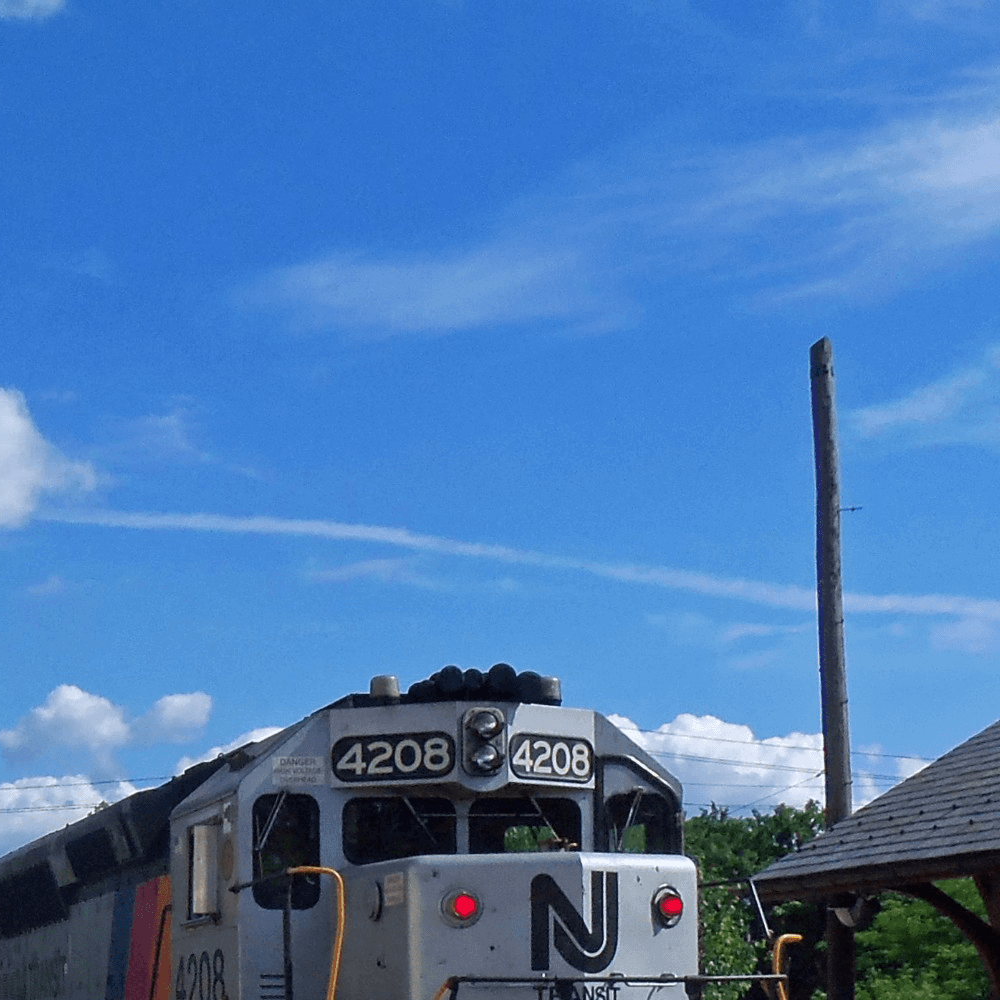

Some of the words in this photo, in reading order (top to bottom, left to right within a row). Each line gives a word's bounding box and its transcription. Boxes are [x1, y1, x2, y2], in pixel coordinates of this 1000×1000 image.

[279, 758, 317, 766] DANGER
[336, 737, 450, 776] 4208
[512, 739, 590, 776] 4208
[530, 870, 618, 974] NJ
